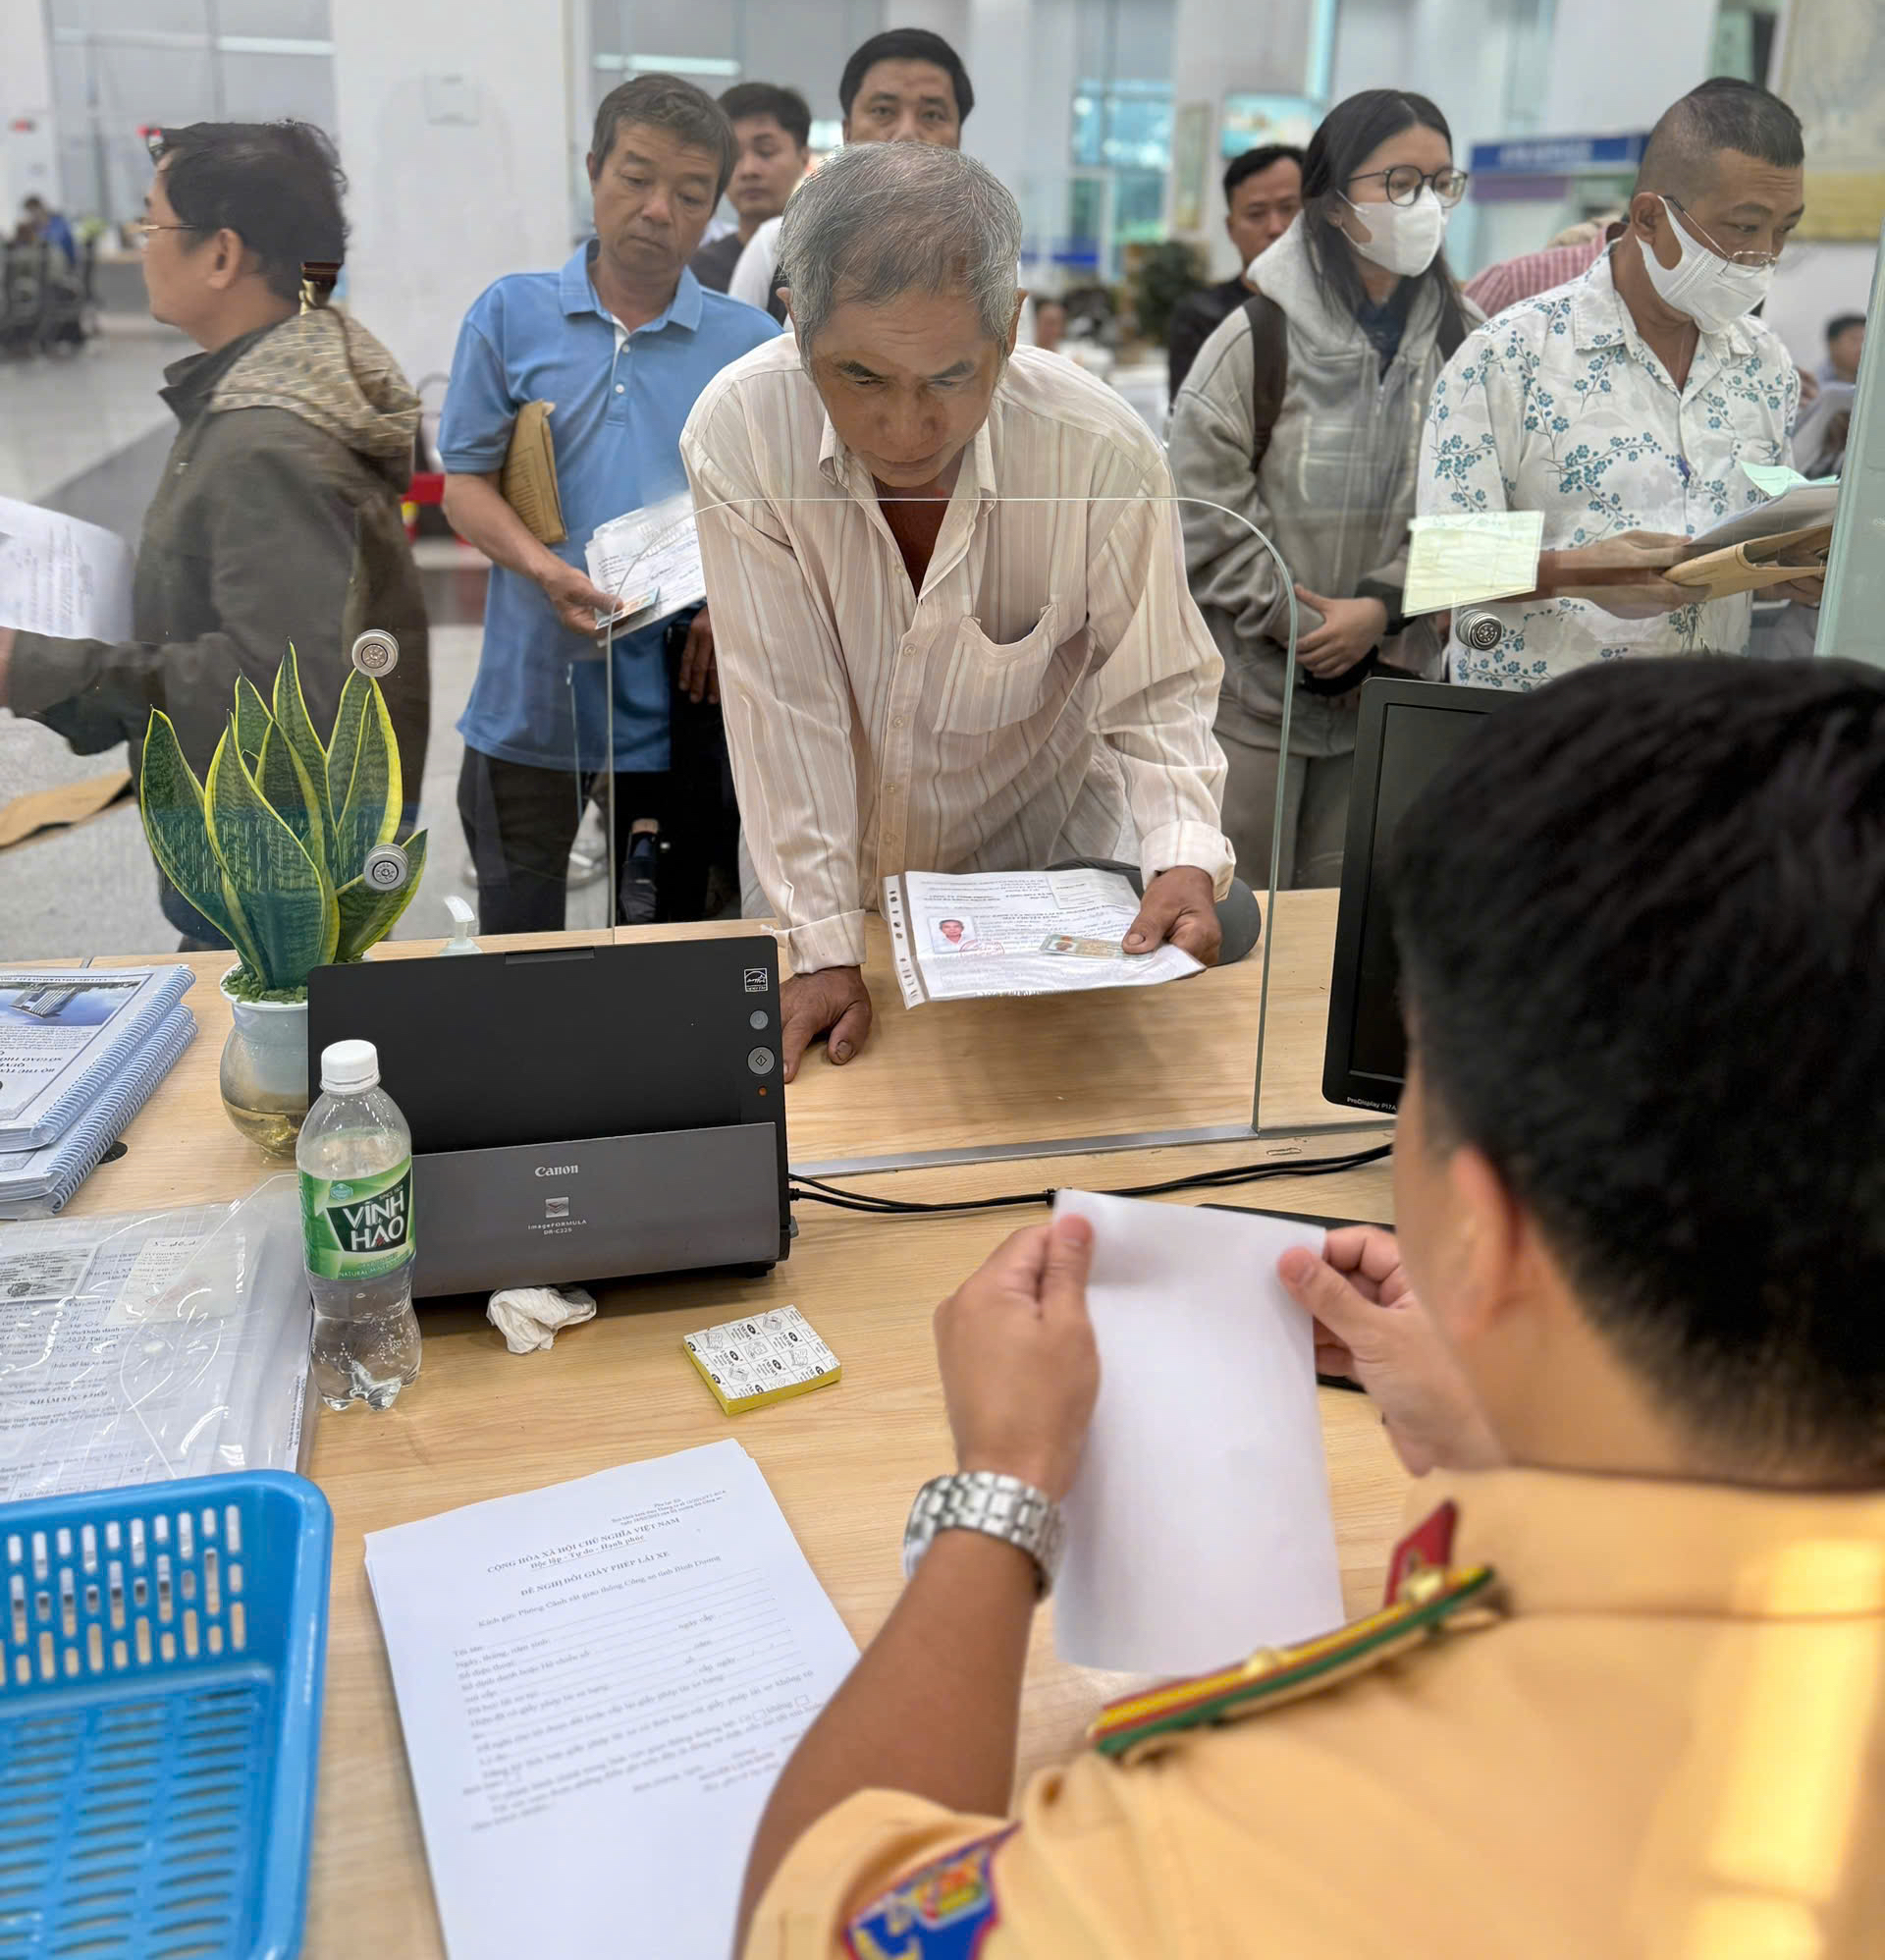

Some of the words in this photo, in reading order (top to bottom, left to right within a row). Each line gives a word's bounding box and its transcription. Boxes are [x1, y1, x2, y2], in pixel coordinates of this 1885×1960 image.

[534, 1165, 579, 1177] Canon
[343, 1190, 404, 1229] VĨNH
[487, 1559, 516, 1573] CỘNG
[557, 1543, 577, 1557] HỘI
[634, 1521, 657, 1535] VIỆT
[658, 1516, 681, 1529] NAM
